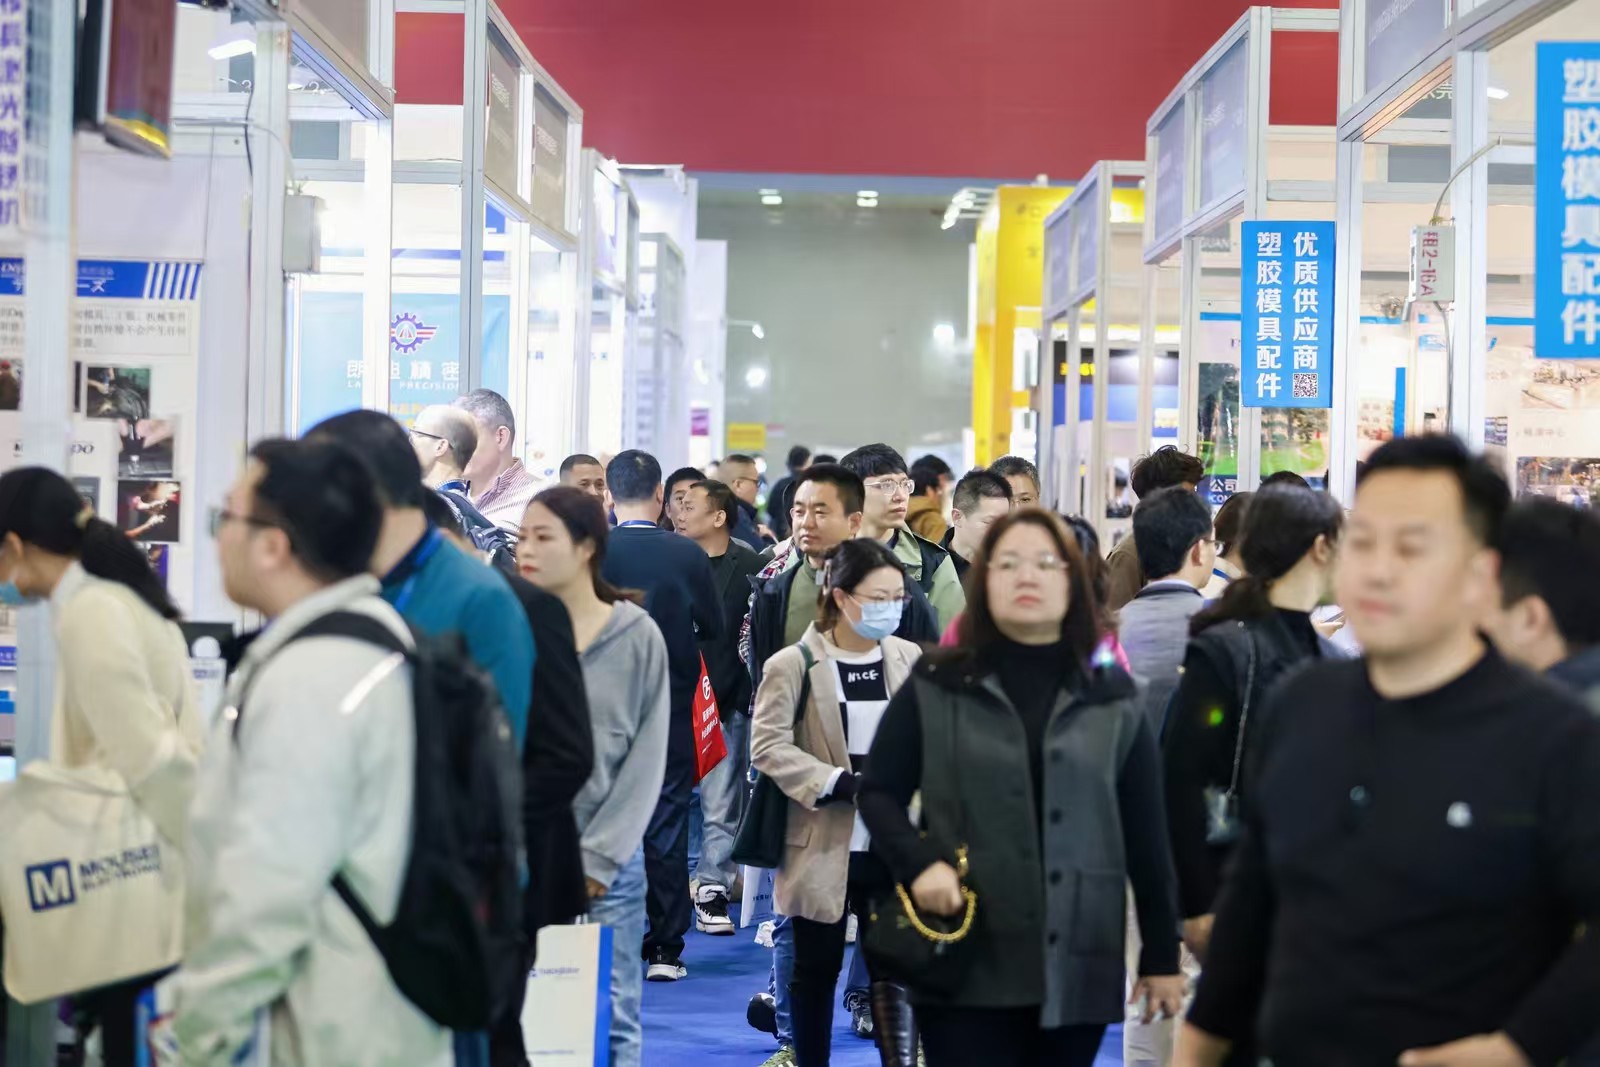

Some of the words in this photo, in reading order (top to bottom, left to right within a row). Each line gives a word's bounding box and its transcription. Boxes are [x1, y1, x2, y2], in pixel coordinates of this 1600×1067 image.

[1256, 232, 1282, 398] 塑胶模具配件
[1293, 232, 1319, 370] 优质供应商
[1210, 479, 1238, 494] 公司
[848, 669, 879, 682] NICE
